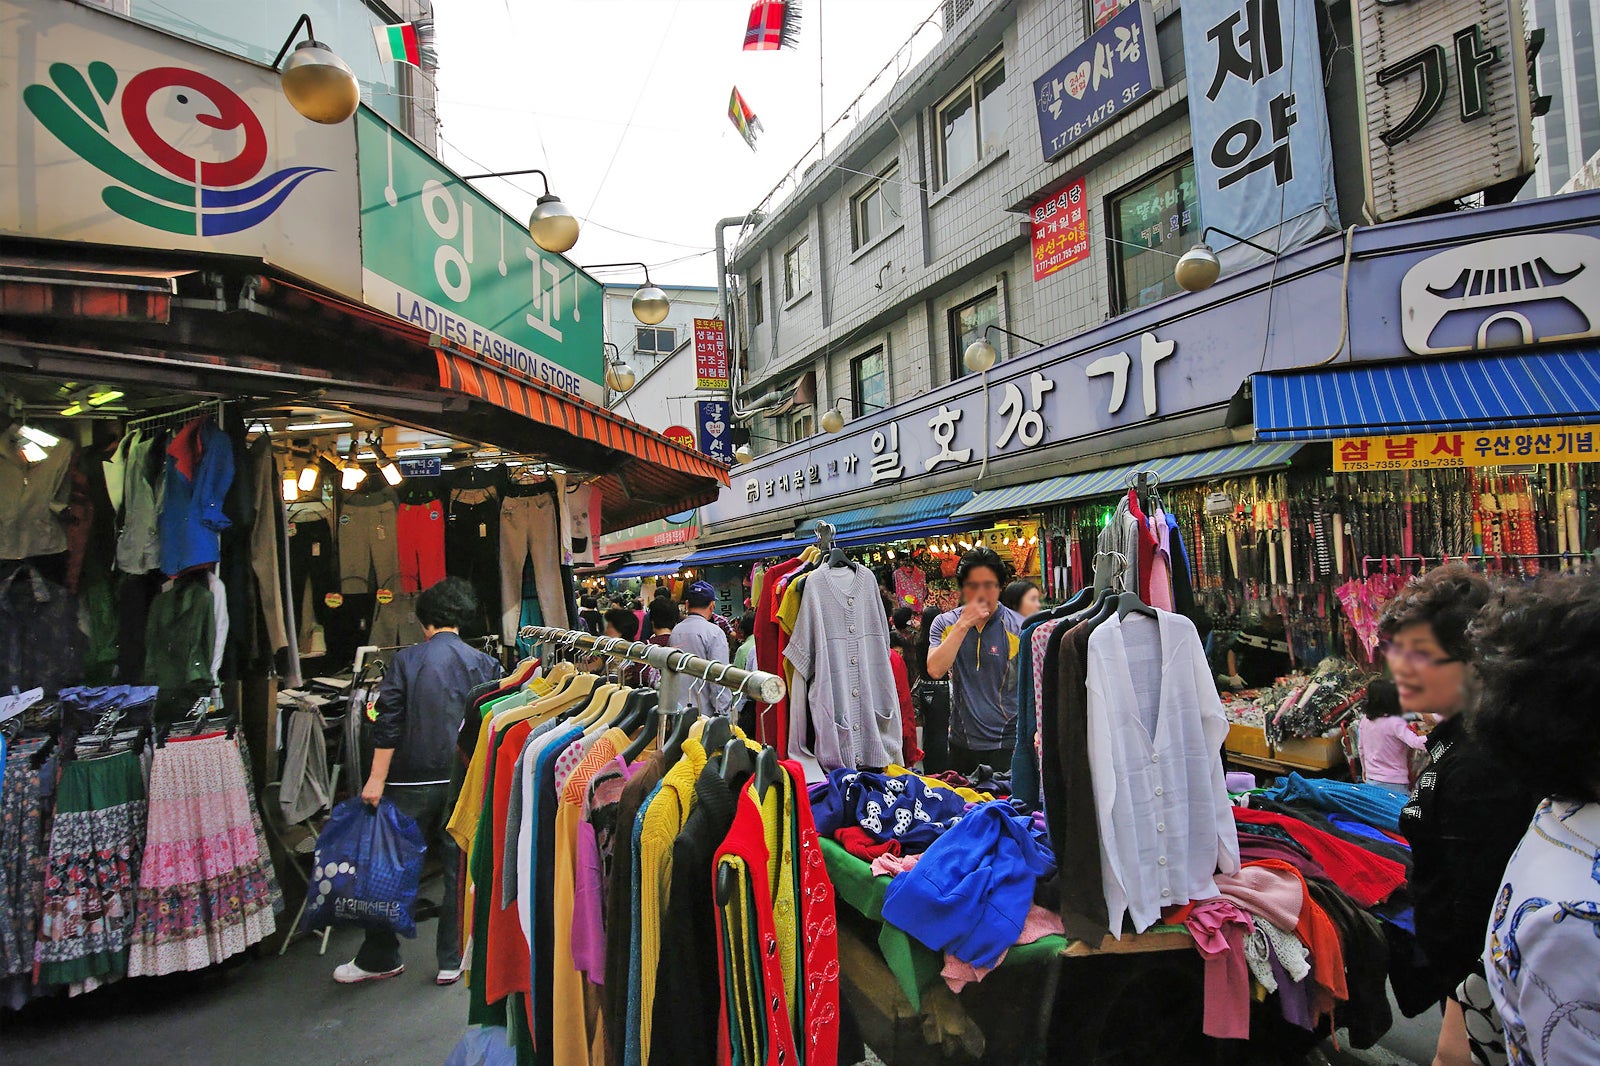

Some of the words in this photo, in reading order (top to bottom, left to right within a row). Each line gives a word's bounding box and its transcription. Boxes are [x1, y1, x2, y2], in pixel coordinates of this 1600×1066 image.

[1069, 70, 1085, 87] 24시
[1092, 23, 1141, 92] 사랑
[1376, 0, 1502, 147] 가
[1050, 99, 1115, 151] T.778-1478
[1121, 82, 1140, 103] 3F
[1206, 0, 1298, 188] 제약
[1035, 226, 1078, 261] 생선구이
[396, 292, 467, 345] LADIES
[473, 329, 537, 378] FASHION
[541, 362, 580, 396] STORE
[696, 331, 706, 377] 생선구이
[699, 379, 728, 388] 755-3573
[870, 332, 1176, 484] 일호상가
[1339, 434, 1465, 462] 삼남사
